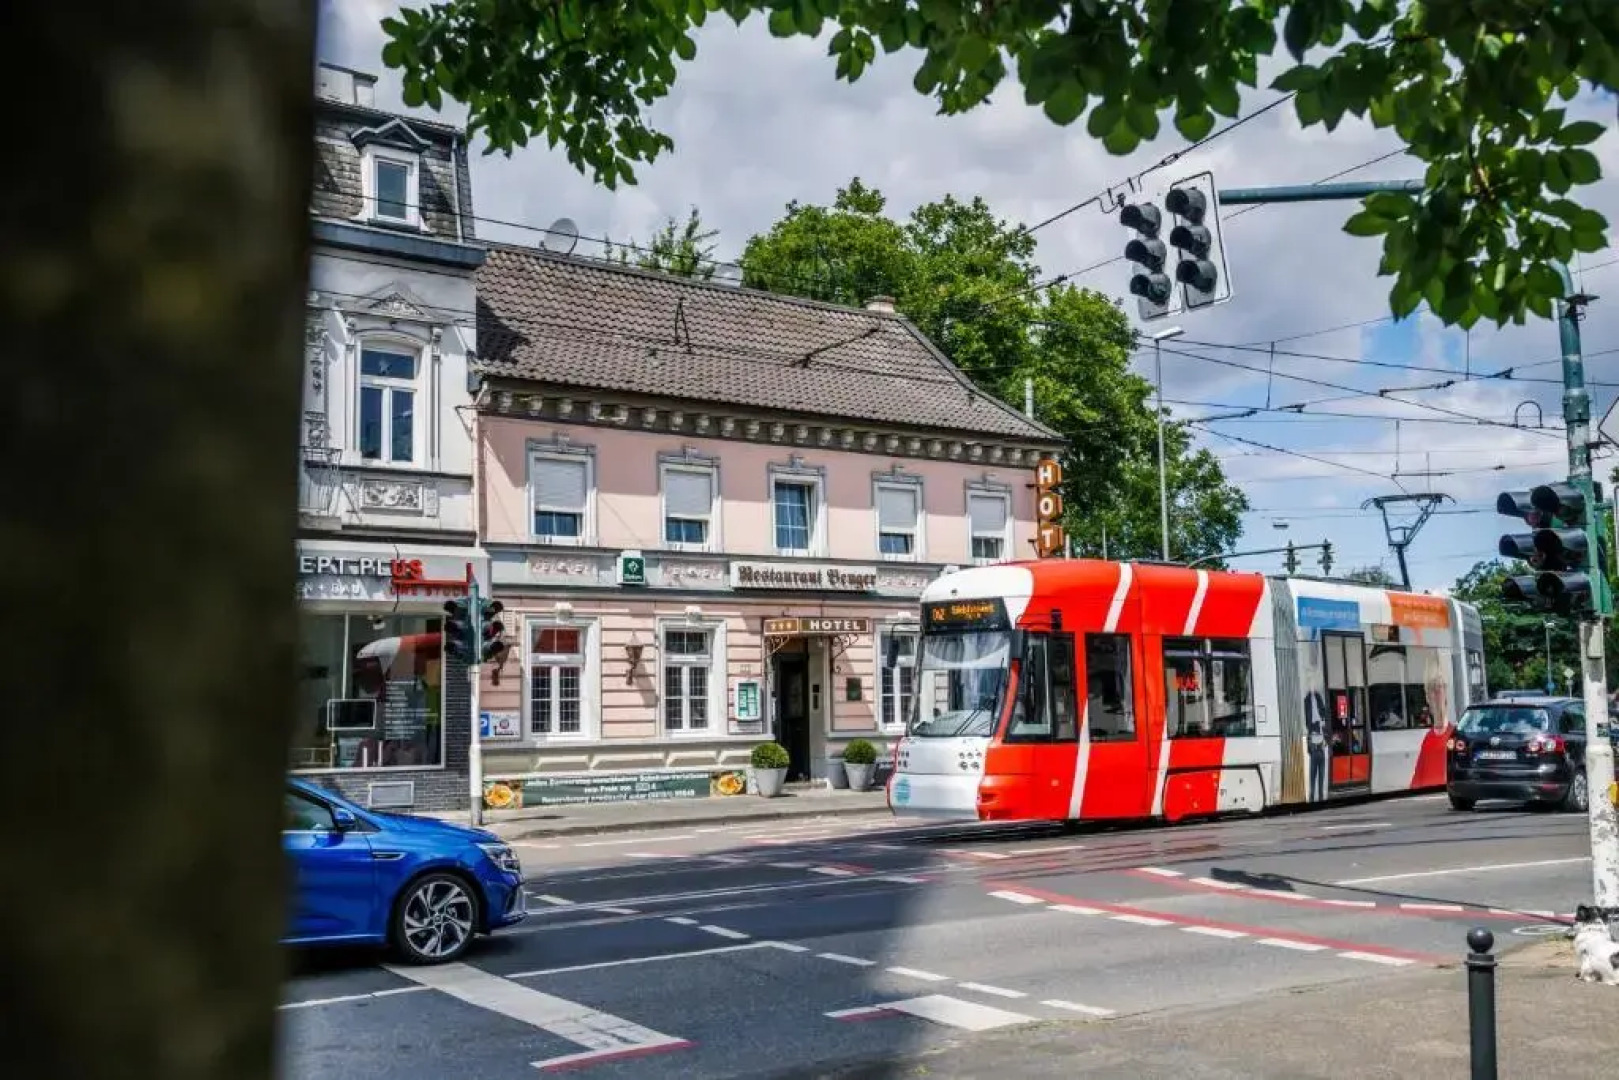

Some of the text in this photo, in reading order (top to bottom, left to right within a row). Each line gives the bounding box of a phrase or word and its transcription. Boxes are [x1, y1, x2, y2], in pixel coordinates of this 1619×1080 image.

[359, 557, 423, 580] PLUS
[738, 565, 823, 584] Restaurant
[810, 620, 861, 631] HOTEL
